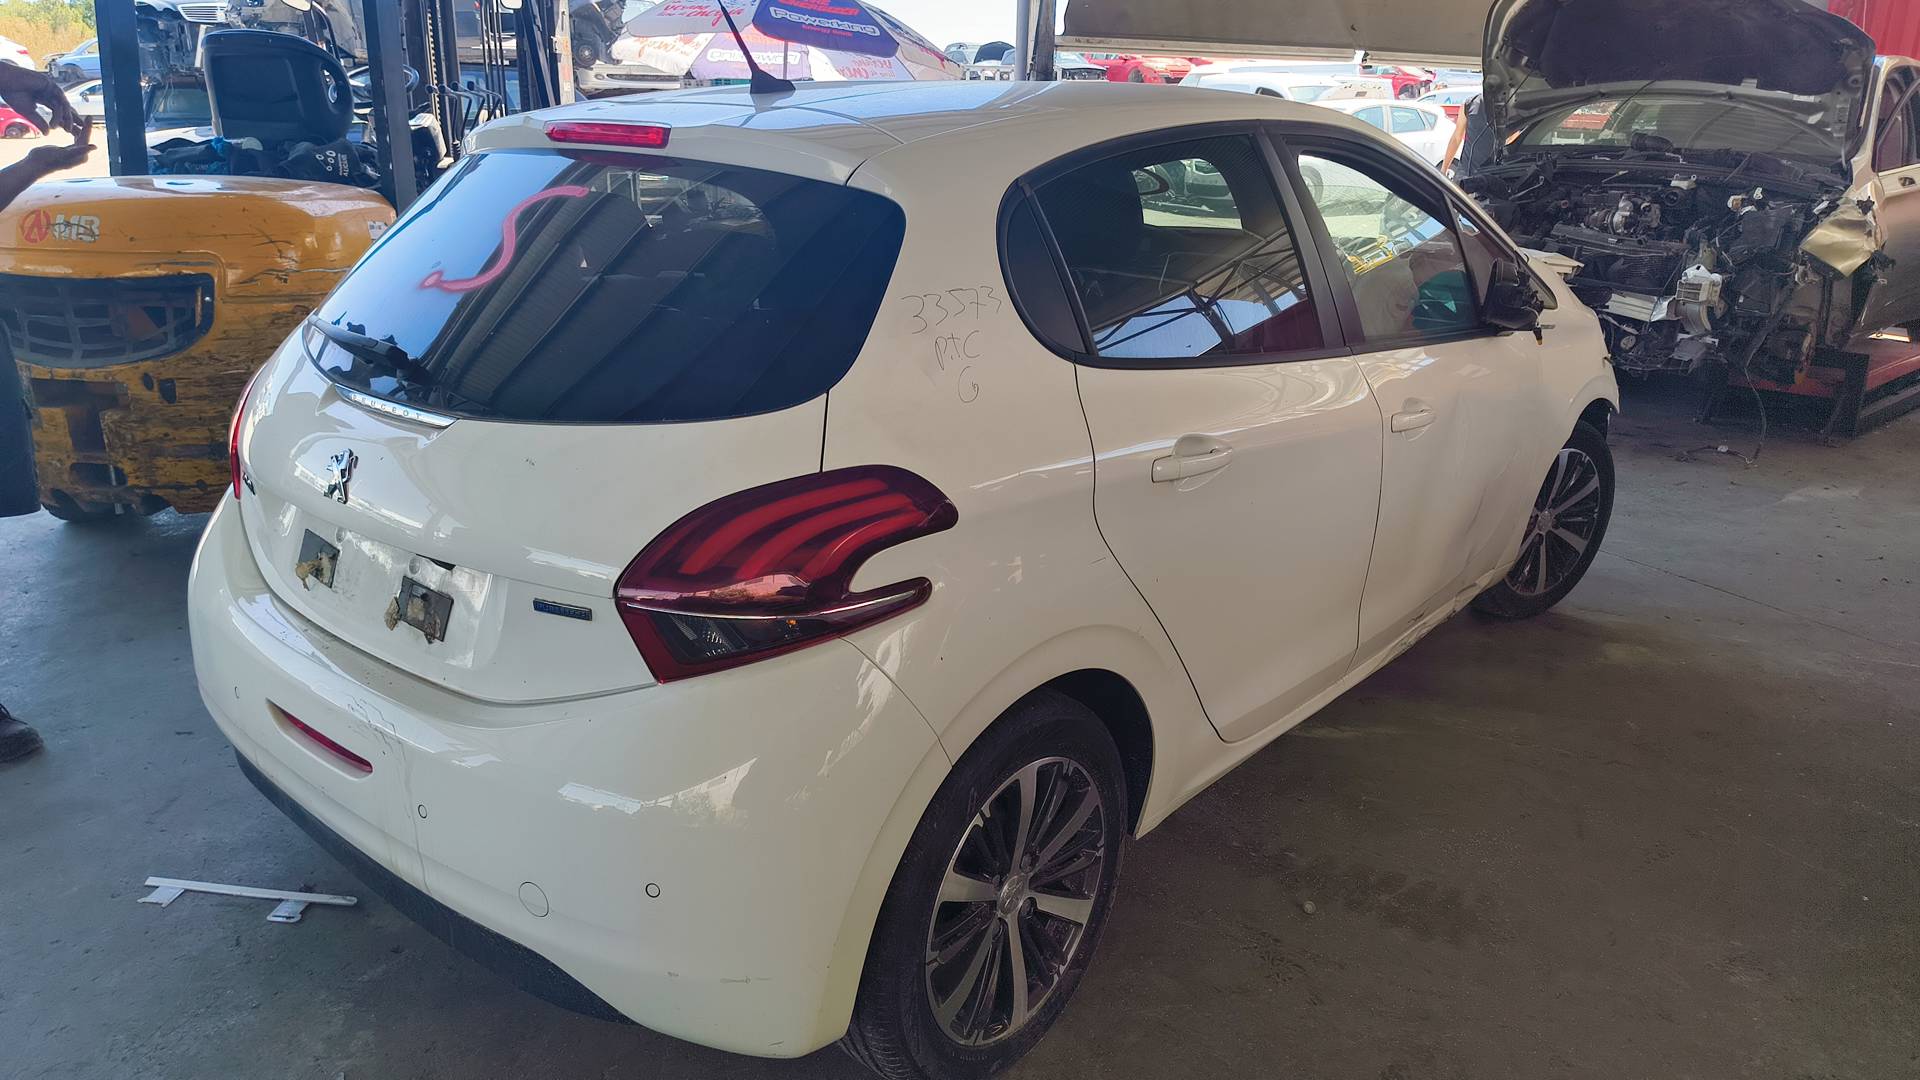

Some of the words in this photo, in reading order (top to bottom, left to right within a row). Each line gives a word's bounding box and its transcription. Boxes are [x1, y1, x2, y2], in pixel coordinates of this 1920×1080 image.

[770, 7, 880, 36] Powerking
[900, 285, 1002, 334] 33573
[351, 393, 424, 420] PEUGEOT
